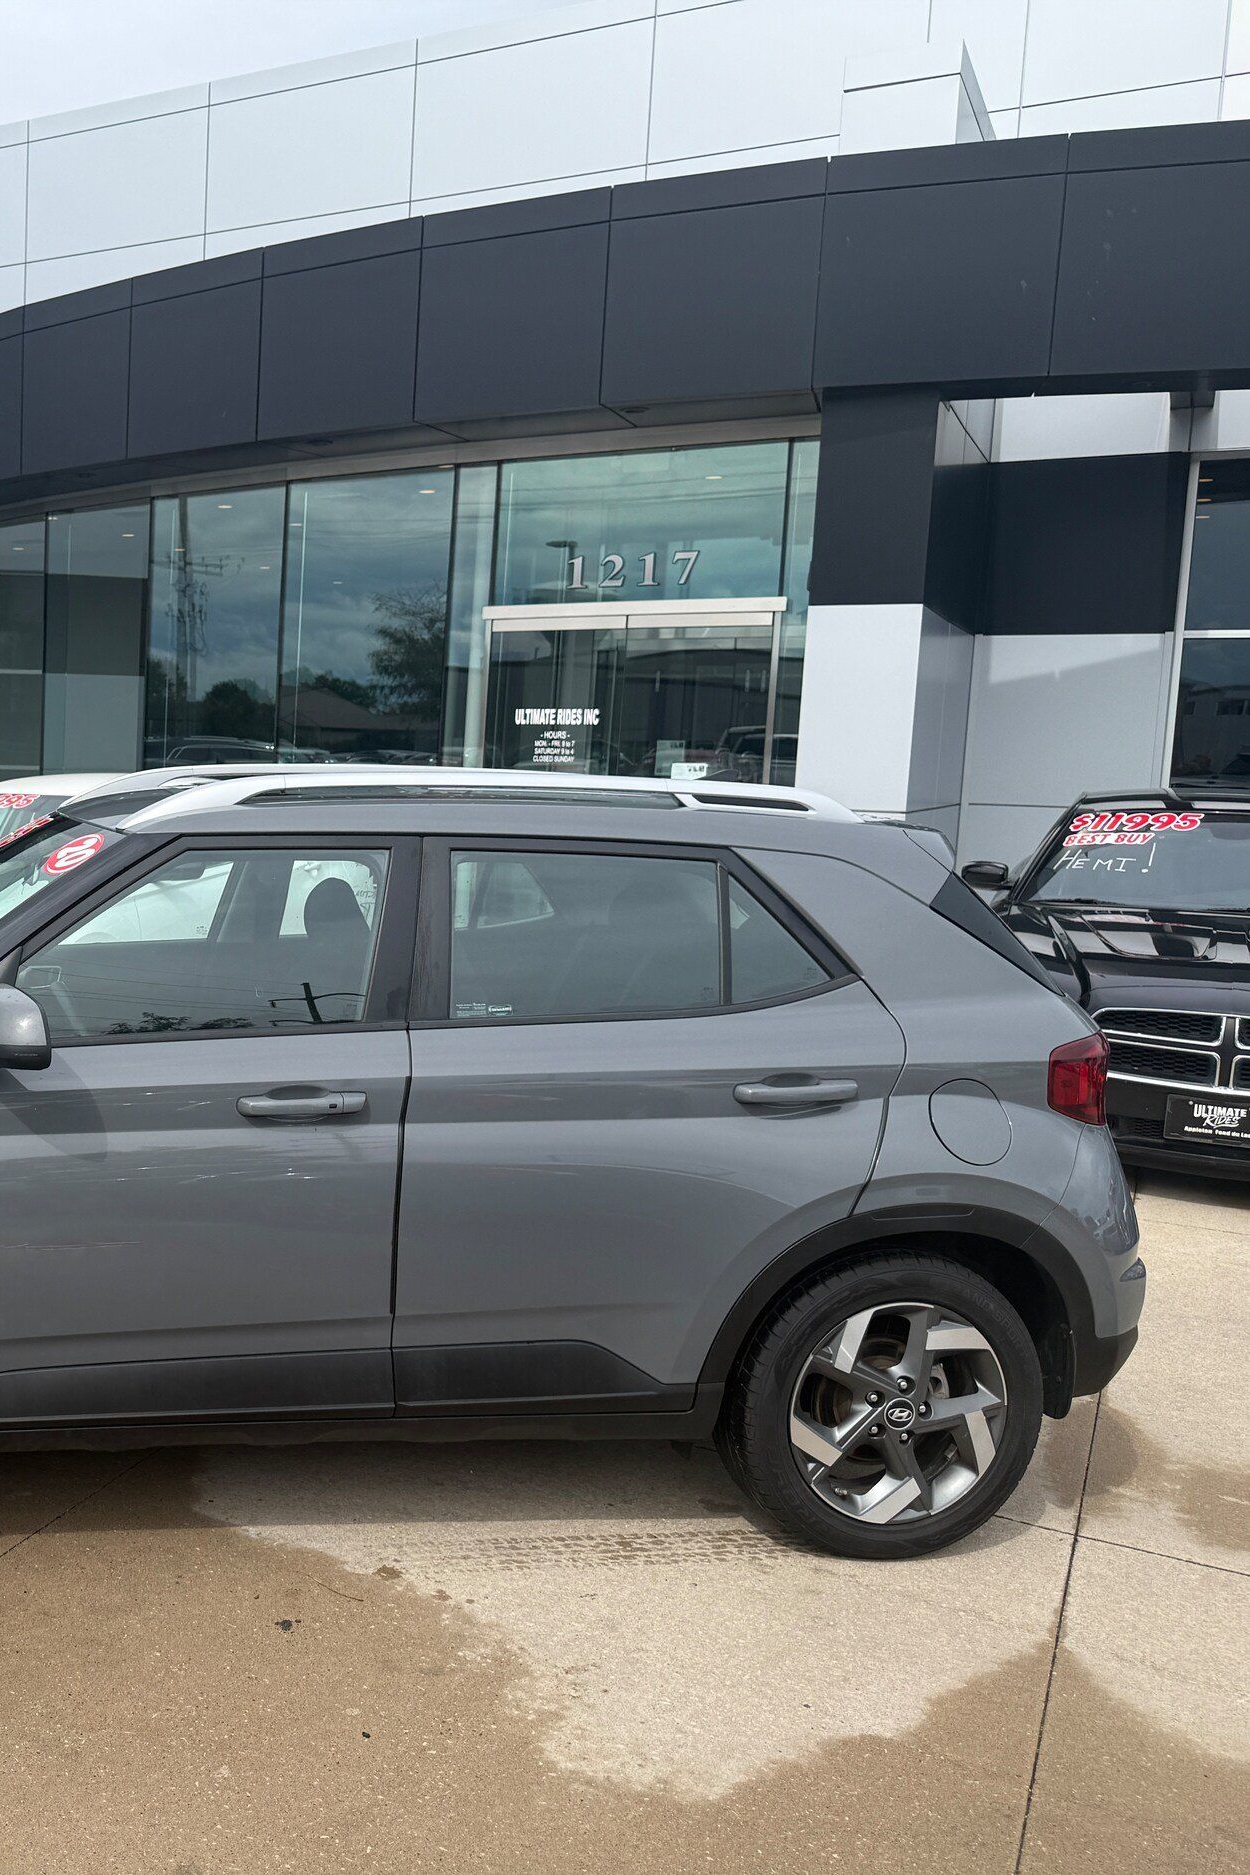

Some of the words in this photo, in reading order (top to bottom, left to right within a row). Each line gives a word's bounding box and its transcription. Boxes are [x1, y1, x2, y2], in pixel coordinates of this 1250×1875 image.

[566, 550, 699, 590] 1217
[515, 708, 556, 725] ULTIMATE
[556, 708, 583, 725] RIDES
[583, 708, 600, 725] INC
[543, 731, 567, 739] HOURS
[1069, 812, 1205, 832] $11995
[1063, 832, 1111, 847] BEST
[1114, 832, 1155, 845] BUY
[1193, 1104, 1247, 1117] ULTIMATE
